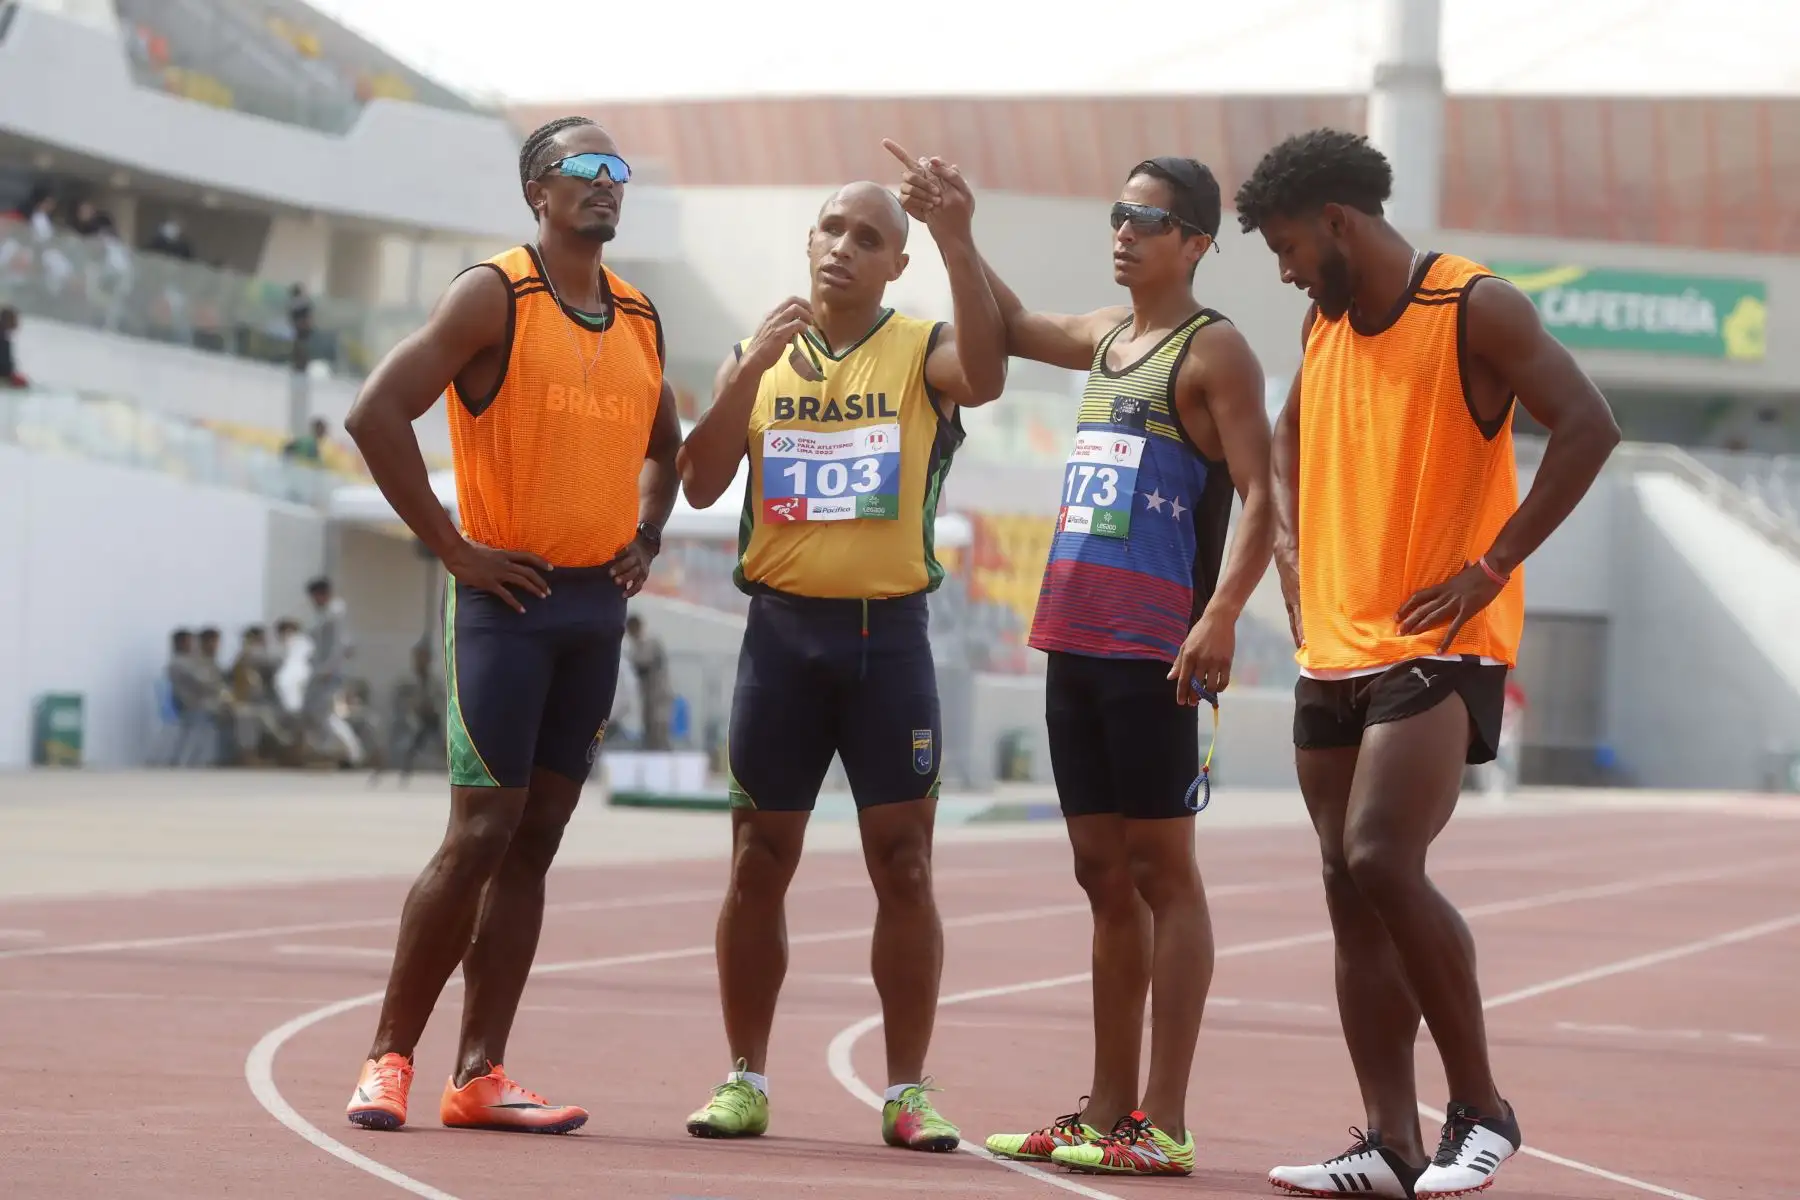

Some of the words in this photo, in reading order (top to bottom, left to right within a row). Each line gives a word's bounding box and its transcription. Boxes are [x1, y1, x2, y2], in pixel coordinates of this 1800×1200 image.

[547, 383, 637, 422] BRASIL
[774, 393, 897, 422] BRASIL
[797, 437, 816, 445] OPEN
[783, 458, 881, 496] 103
[1066, 465, 1119, 507] 173
